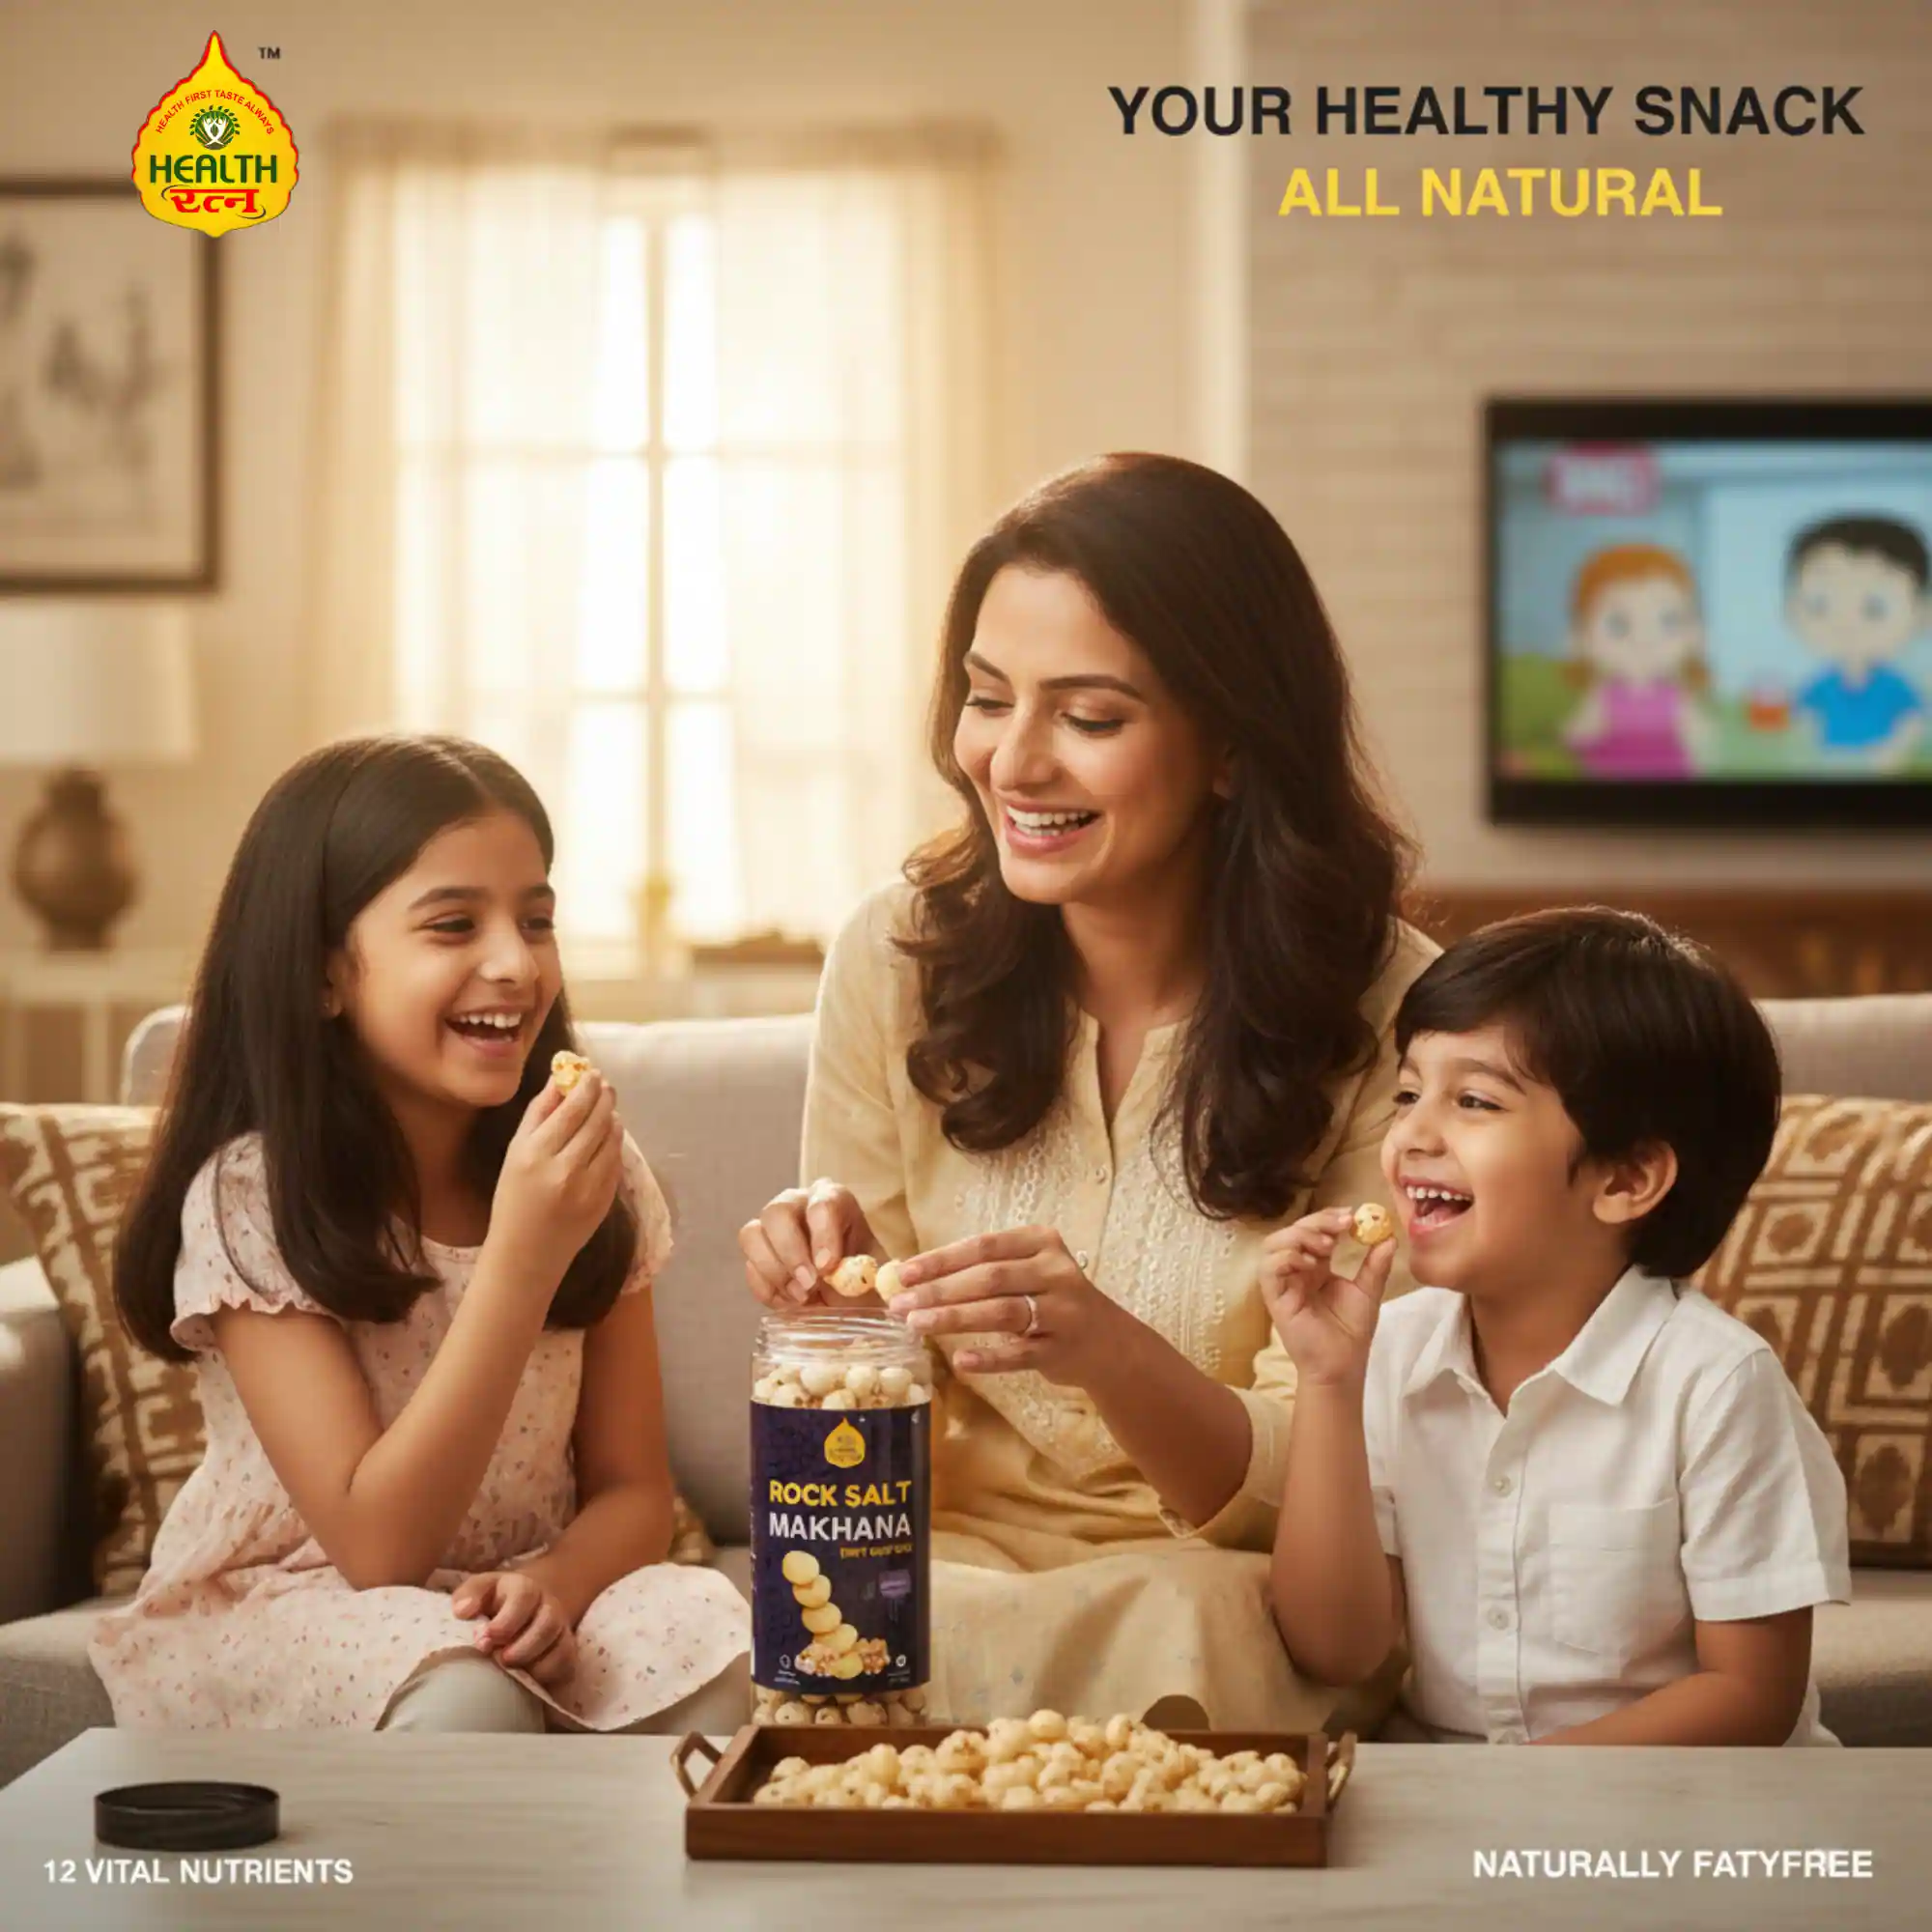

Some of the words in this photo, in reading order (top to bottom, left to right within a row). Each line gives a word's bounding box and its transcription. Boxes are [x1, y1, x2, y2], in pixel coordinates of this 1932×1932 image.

[769, 1479, 838, 1507] ROCK
[844, 1480, 912, 1508] SALT
[769, 1511, 912, 1542] MAKHANA
